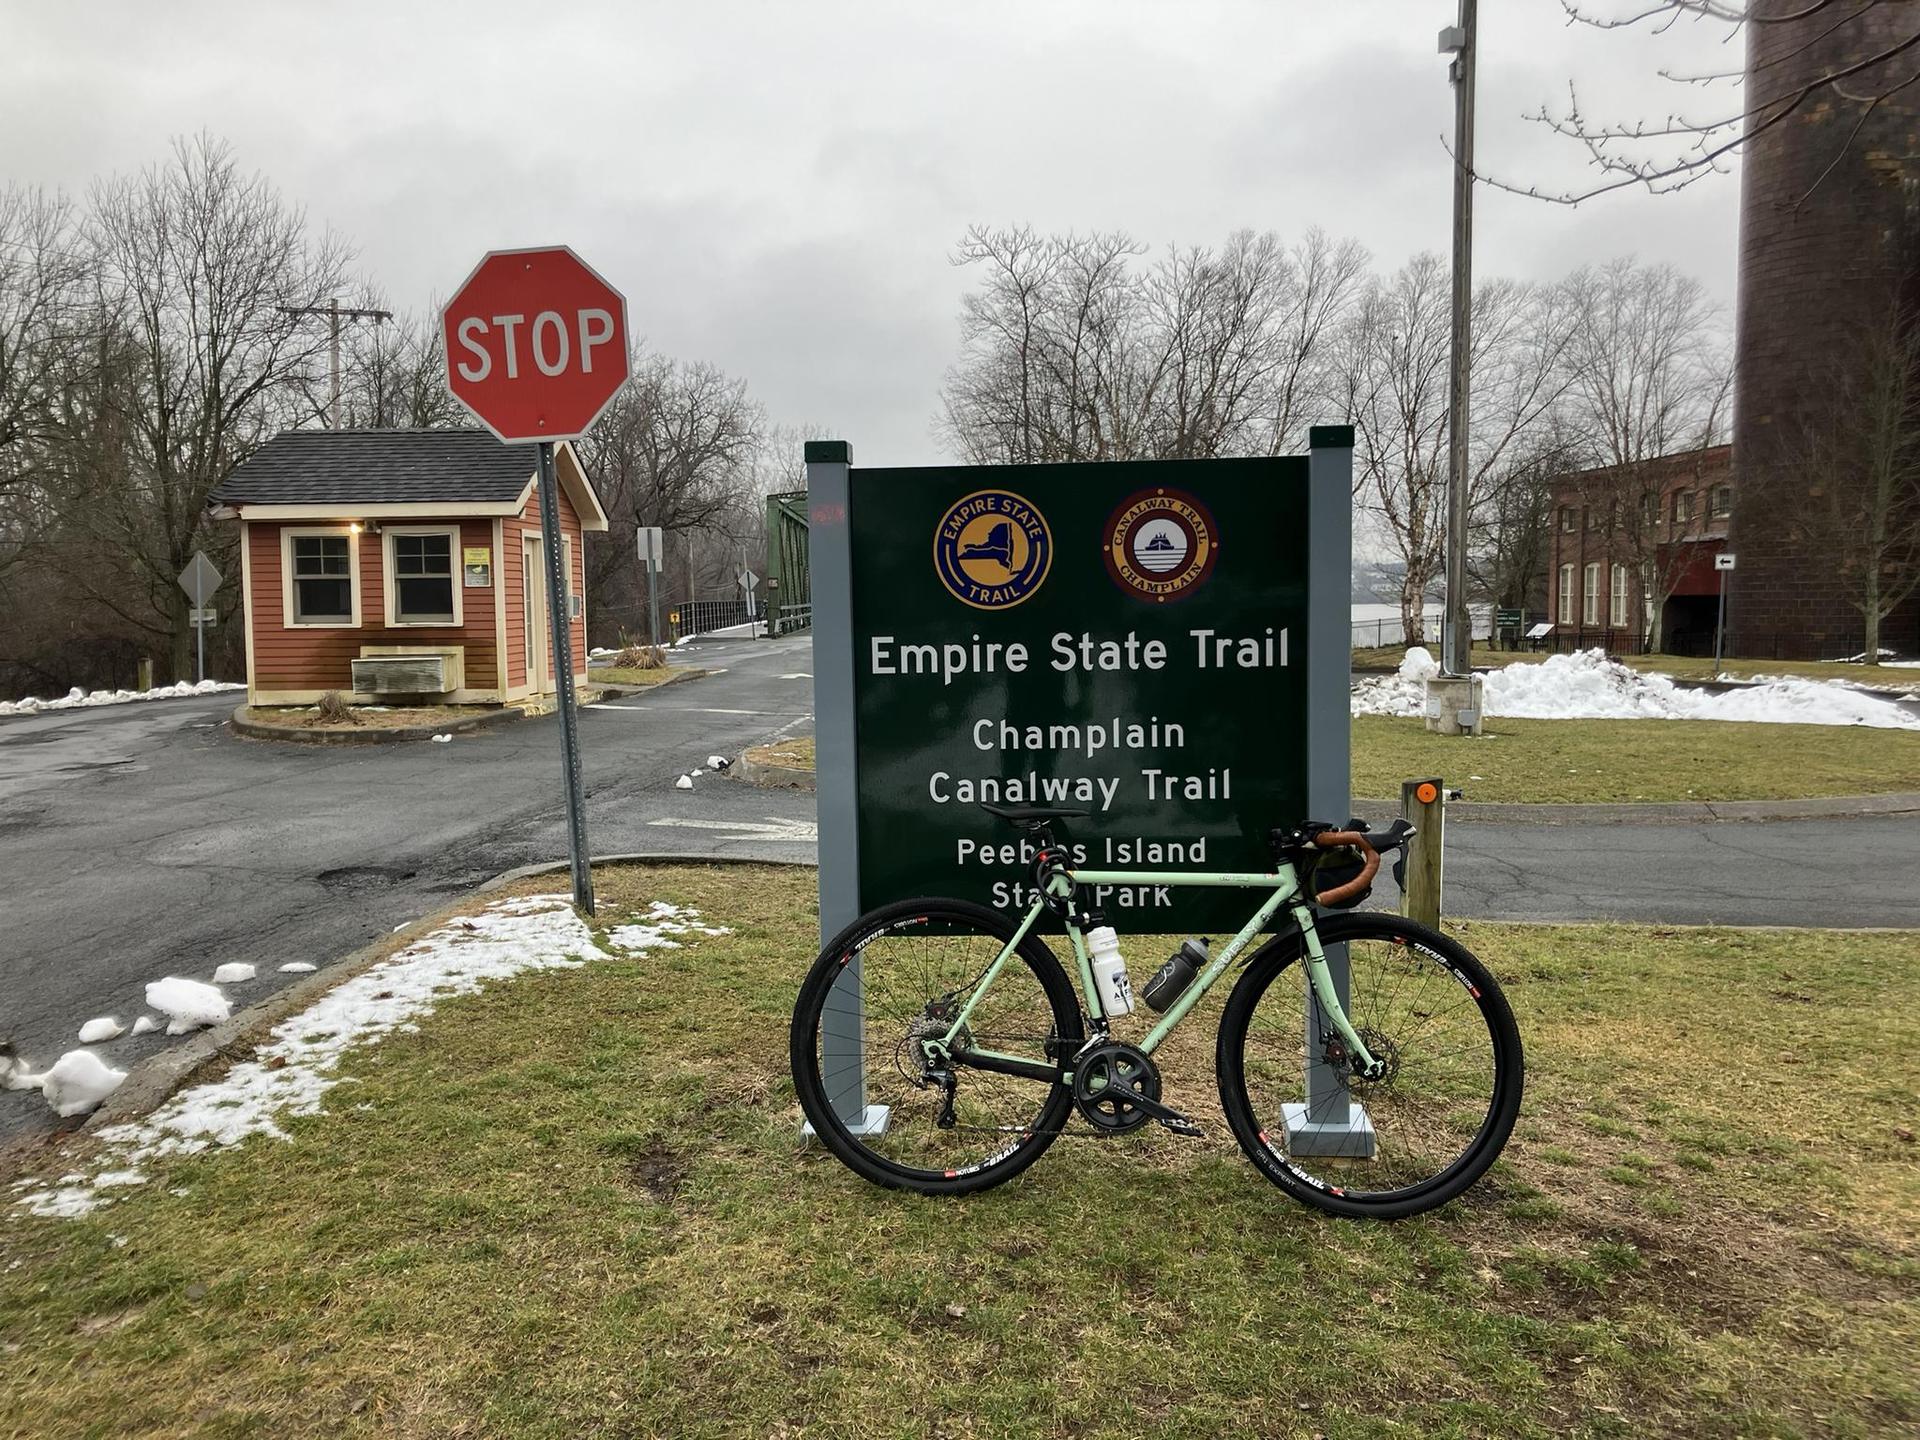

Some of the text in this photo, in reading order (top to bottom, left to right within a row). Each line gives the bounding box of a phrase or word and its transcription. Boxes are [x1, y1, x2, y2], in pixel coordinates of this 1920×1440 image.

[457, 308, 614, 382] STOP
[943, 497, 1042, 540] EMPIRE STATE
[1114, 498, 1208, 546] CANALWAY TRAIL
[968, 585, 1020, 603] TRAIL
[1120, 562, 1202, 593] CHAMPLAIN
[871, 627, 1289, 686] Empire State Trail
[973, 716, 1184, 758] Champlain
[929, 768, 1231, 811] Canalway Trail
[957, 836, 1206, 865] Peebs Island
[1096, 885, 1172, 907] Park
